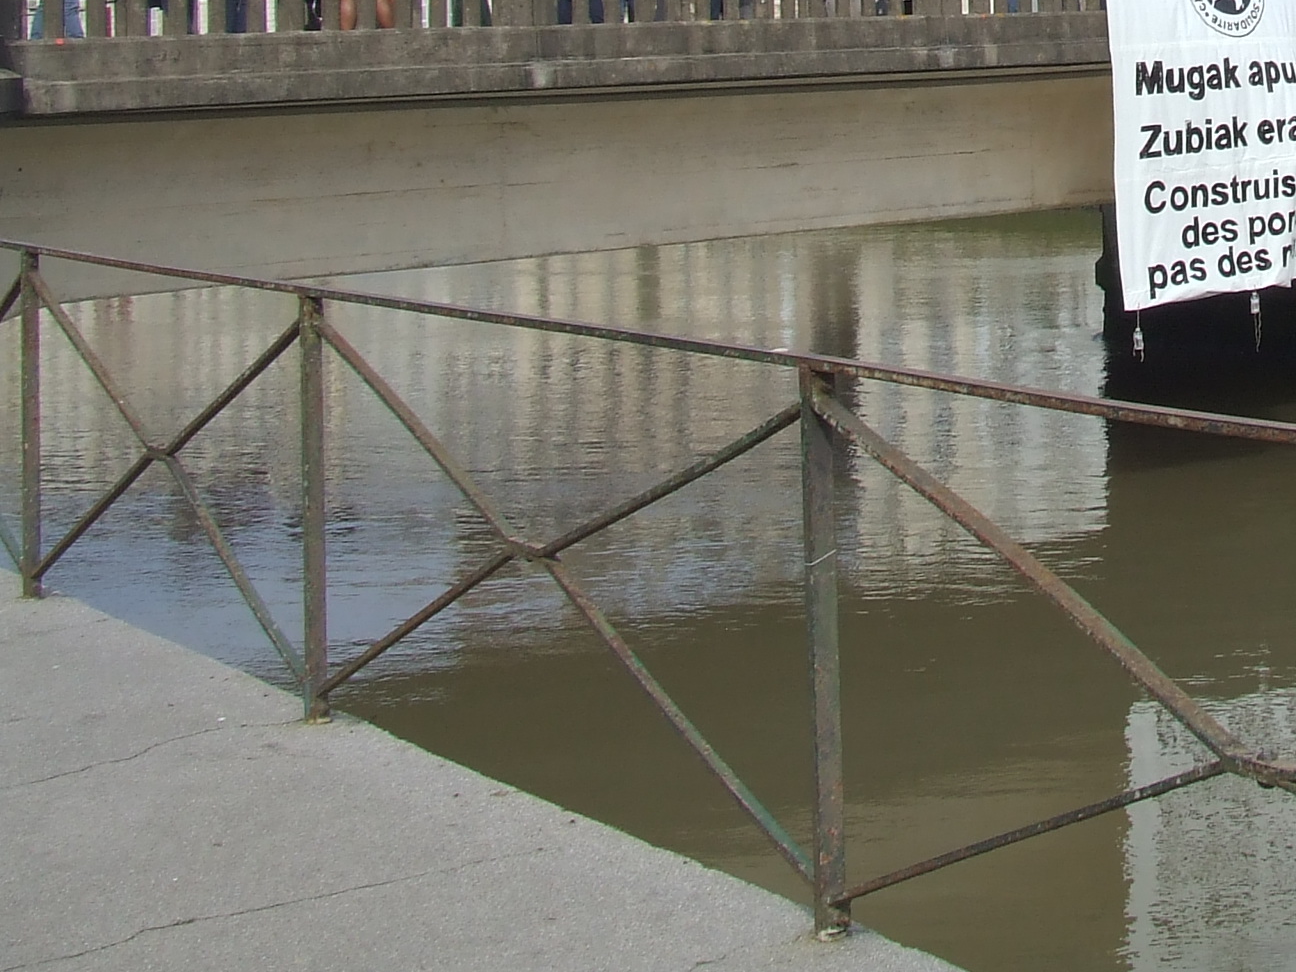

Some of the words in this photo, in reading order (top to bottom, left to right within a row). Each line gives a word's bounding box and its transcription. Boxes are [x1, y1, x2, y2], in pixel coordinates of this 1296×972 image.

[1135, 57, 1241, 100] Mugak
[1139, 116, 1248, 160] Zubiak
[1182, 216, 1238, 249] des
[1148, 258, 1207, 299] pas
[1217, 246, 1272, 277] des
